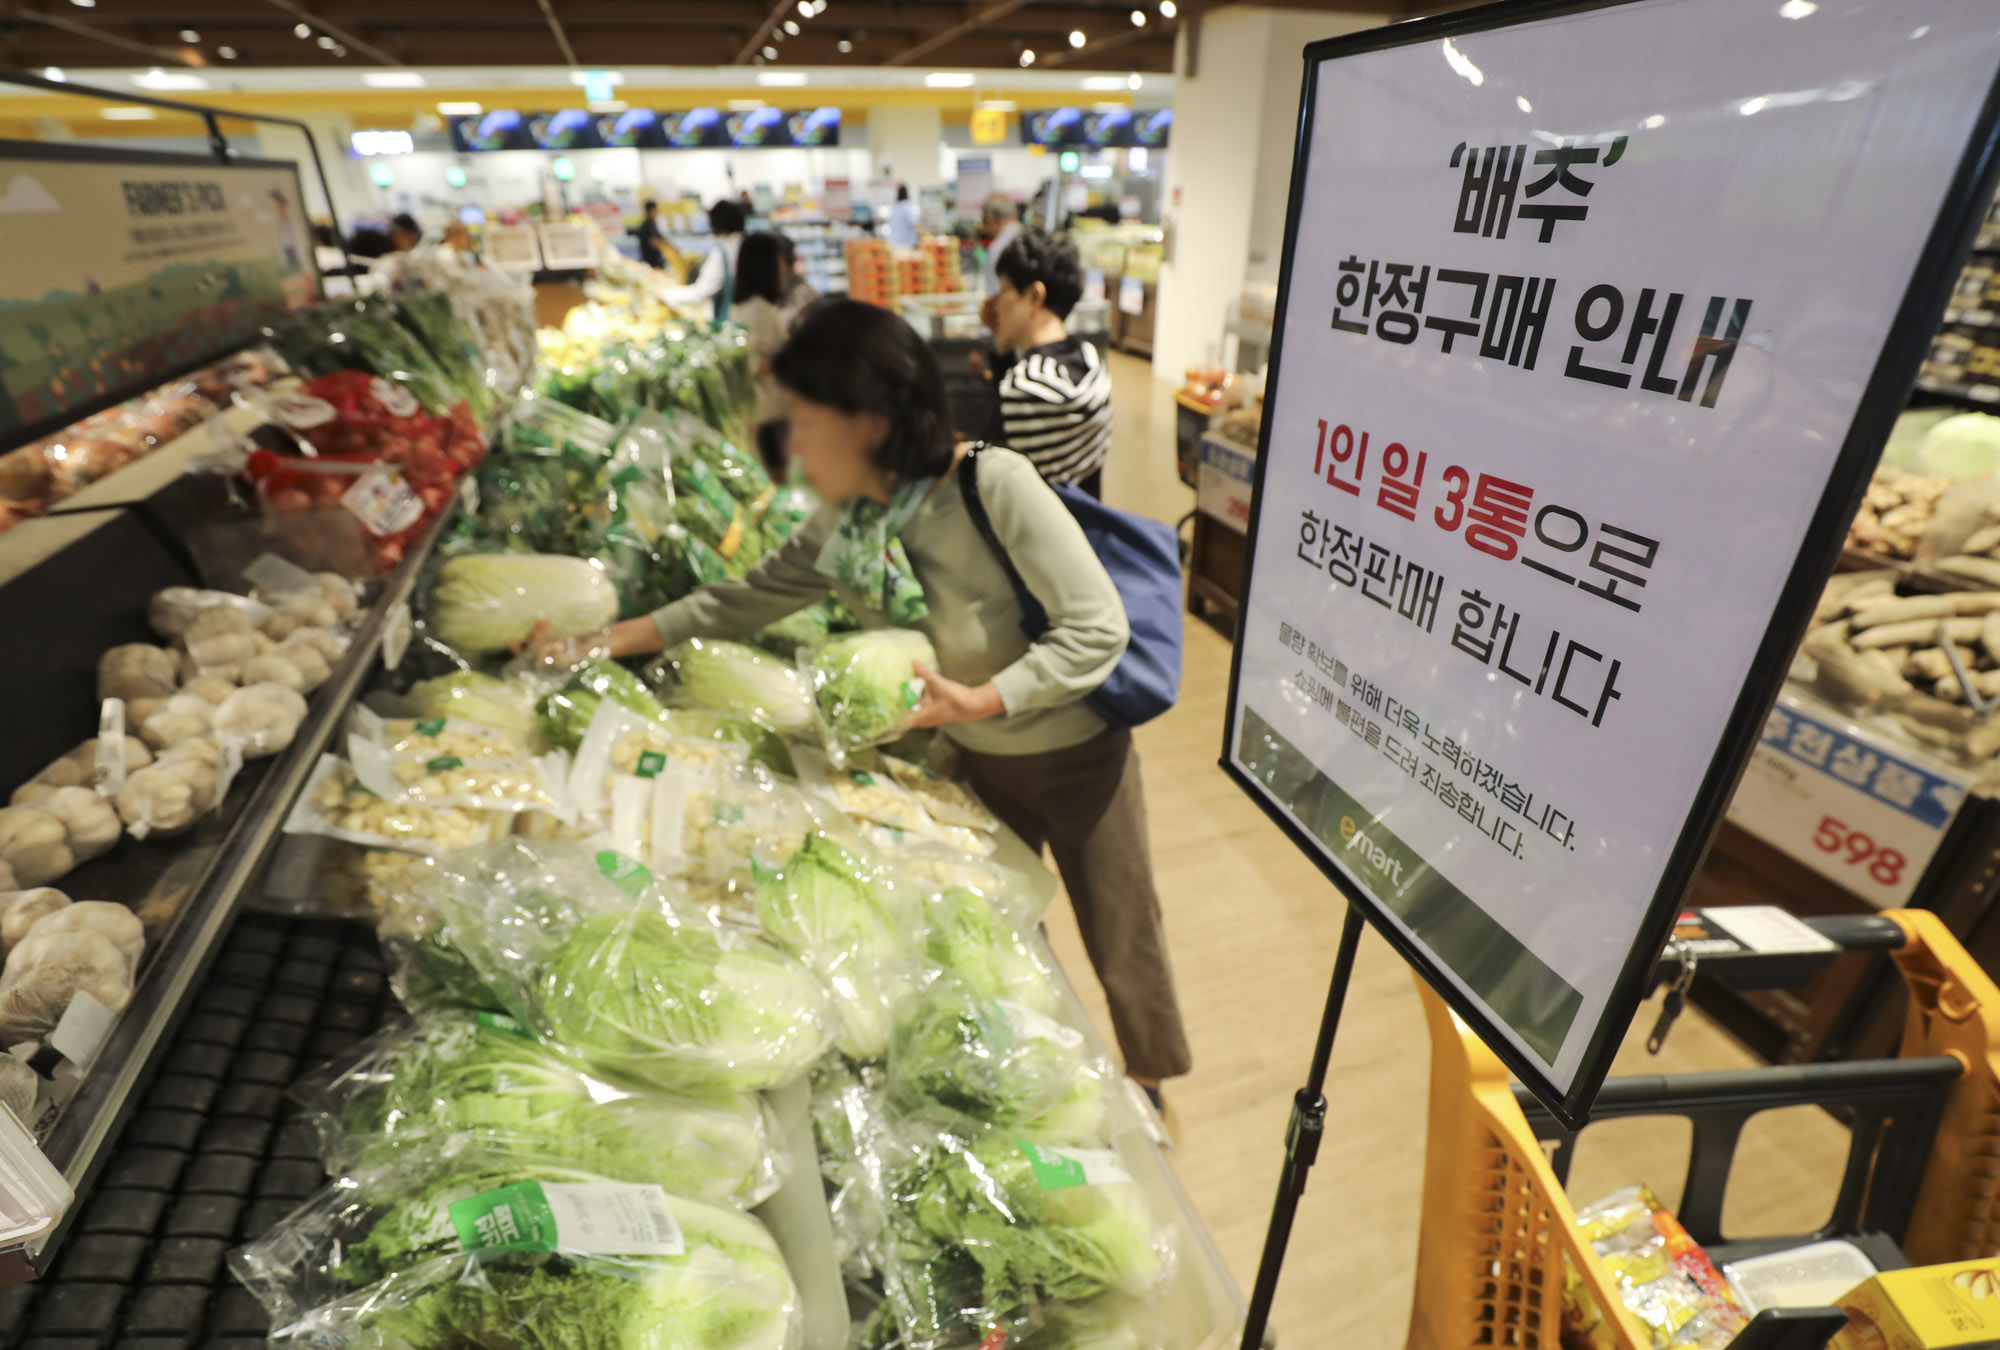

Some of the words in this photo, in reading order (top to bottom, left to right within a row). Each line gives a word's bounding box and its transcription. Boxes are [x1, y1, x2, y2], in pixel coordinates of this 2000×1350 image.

[1331, 254, 1557, 371] 한정구매
[1563, 283, 1753, 410] 안내
[1314, 418, 1369, 497] 1인
[1377, 442, 1427, 522] 일
[1434, 464, 1660, 613] 3통으로
[1297, 510, 1444, 634] 한정판매
[1451, 589, 1622, 728] 합니다
[1278, 621, 1306, 656] 물량
[1307, 641, 1348, 688] 확보를
[1351, 673, 1383, 713] 위해
[1384, 696, 1421, 740] 더욱
[1422, 723, 1575, 852] 노력하겠습니다.
[1294, 669, 1334, 713] 쇼핑에
[1335, 698, 1382, 751] 불편을
[1383, 735, 1419, 779] 드려
[1420, 762, 1524, 861] 죄송합니다.
[1340, 815, 1403, 887] emart
[1812, 812, 1908, 888] 598
